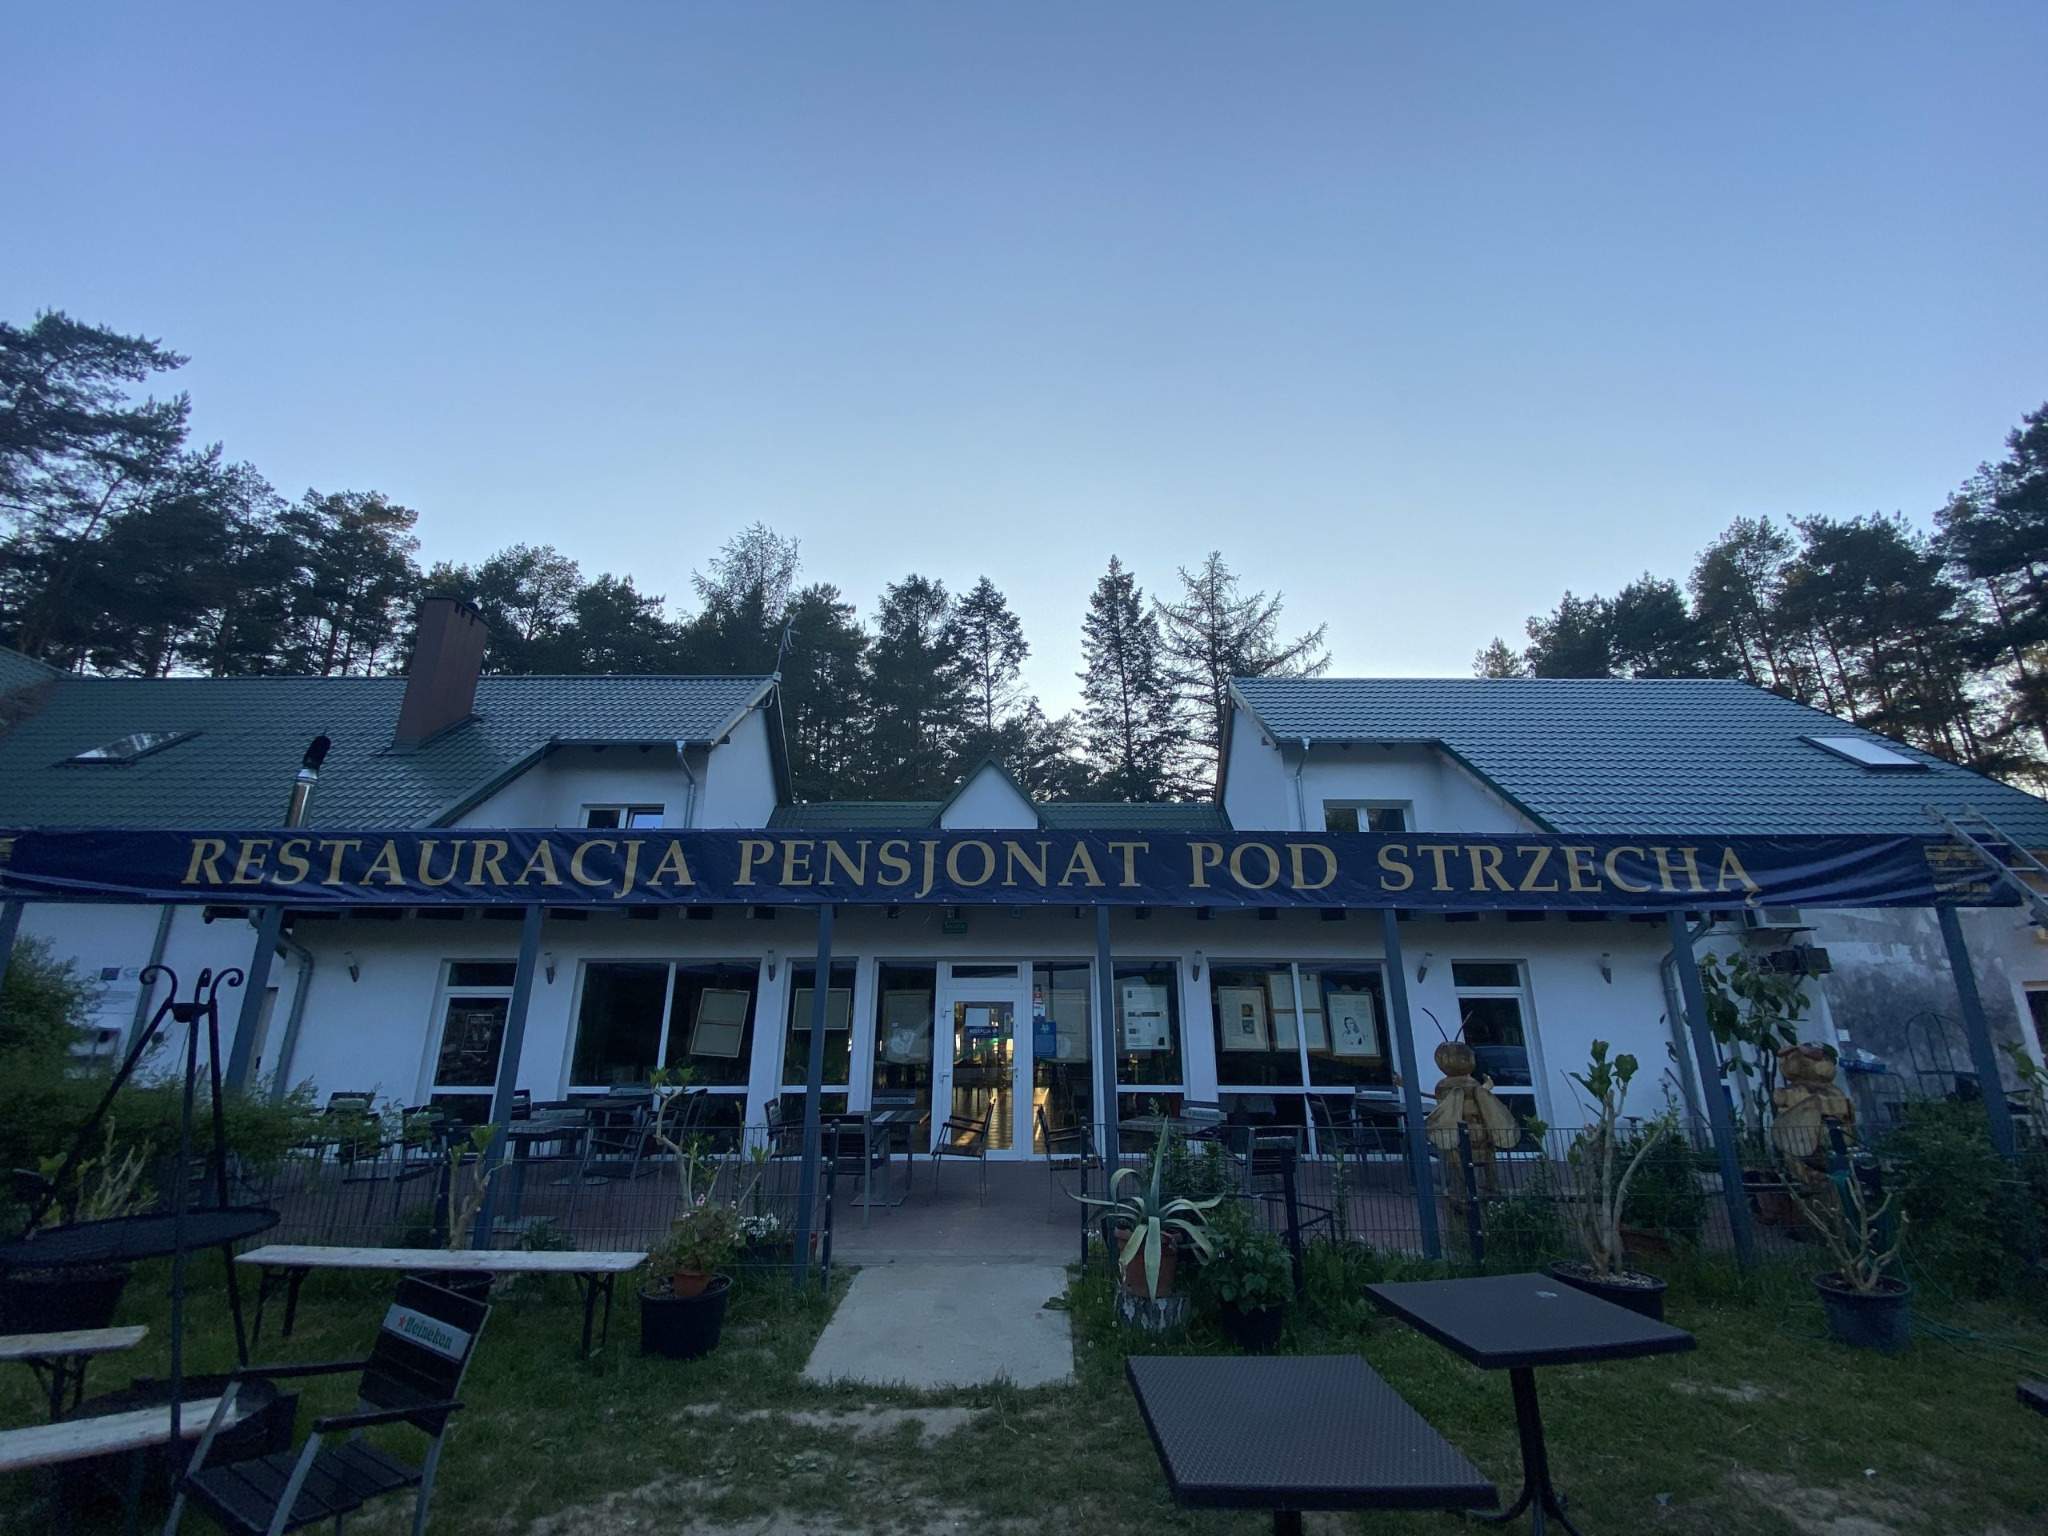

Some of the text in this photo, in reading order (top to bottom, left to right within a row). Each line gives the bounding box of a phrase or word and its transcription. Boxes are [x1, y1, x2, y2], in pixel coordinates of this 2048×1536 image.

[182, 838, 1762, 908] RESTAURACJA PENSJONAT POD STRZECHĄ
[404, 1316, 453, 1350] Heineken
